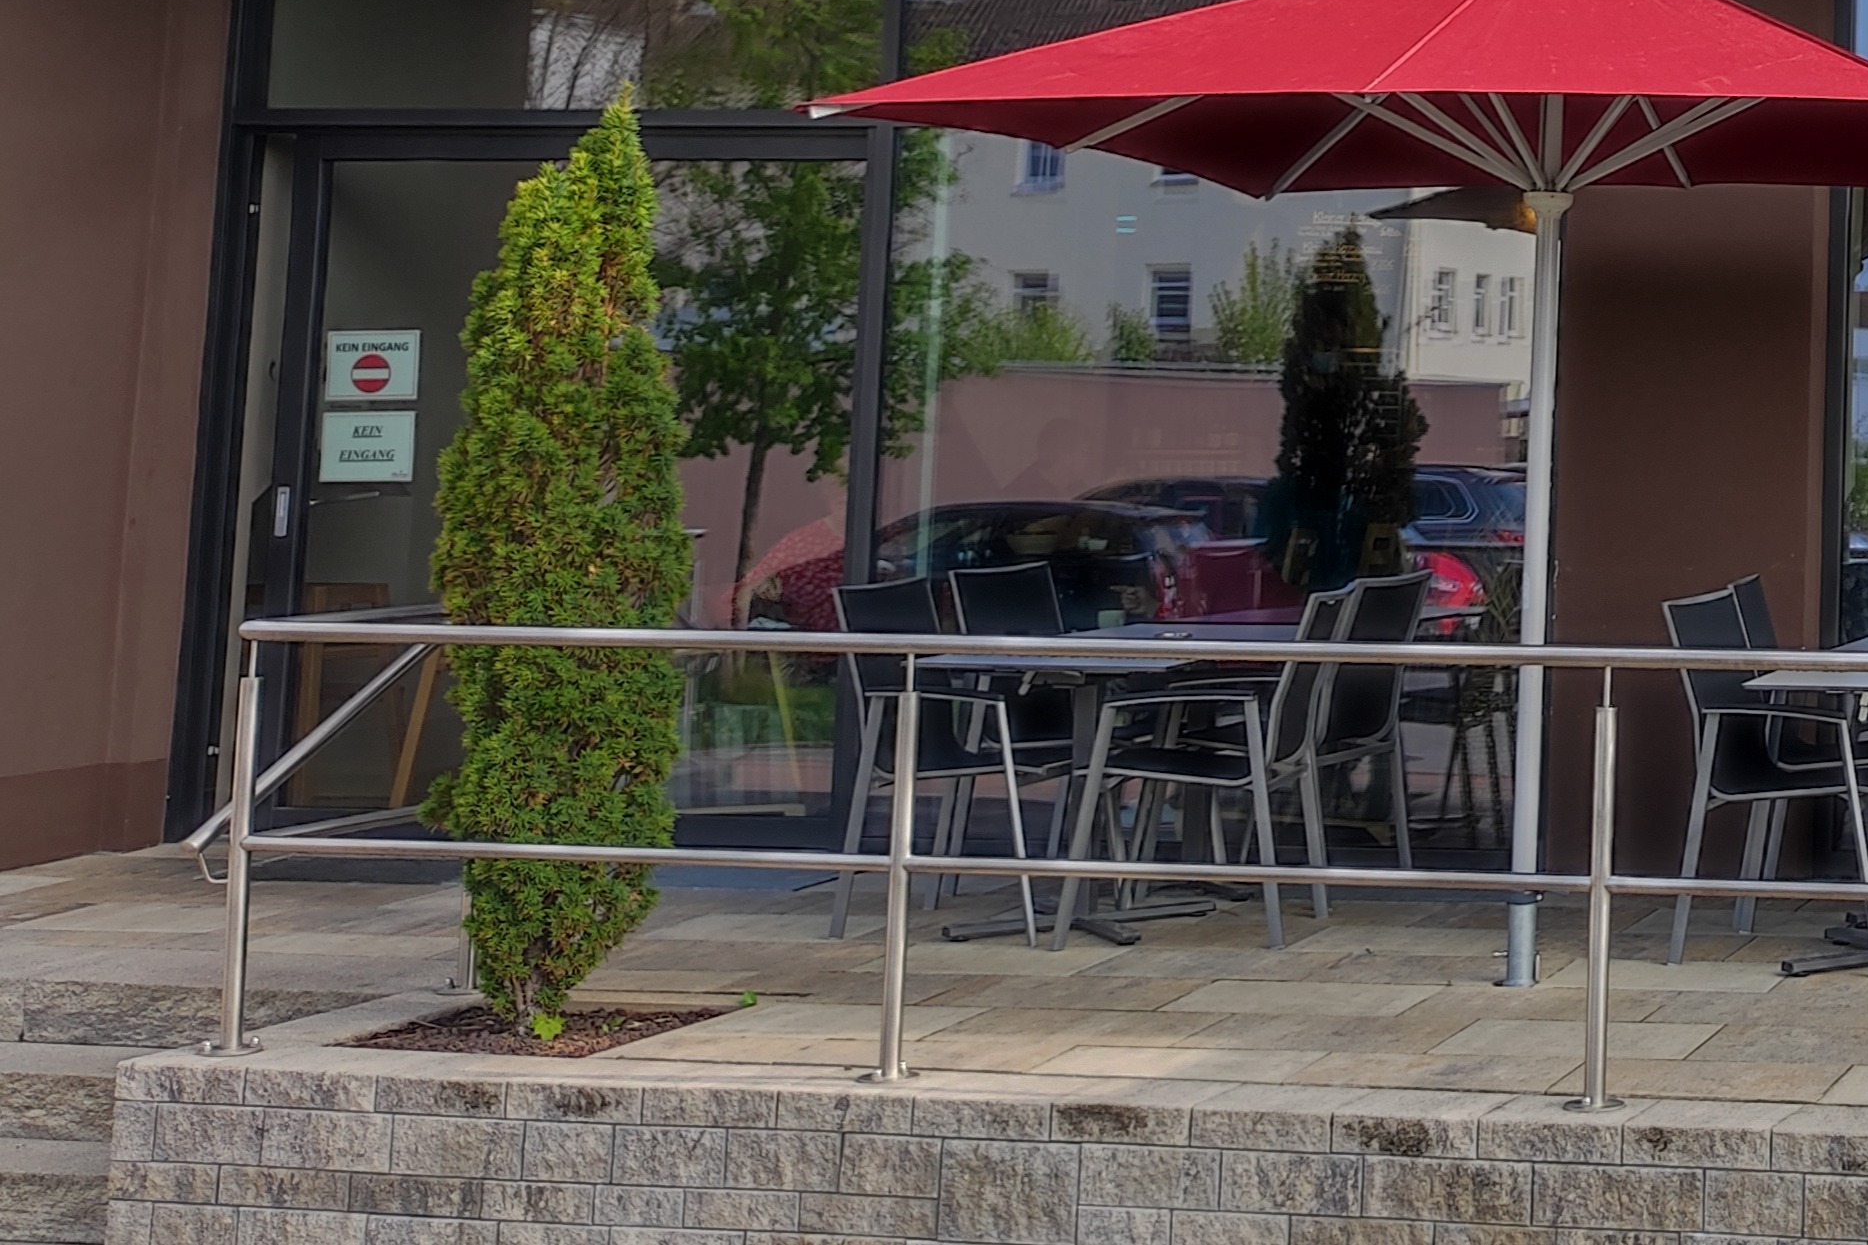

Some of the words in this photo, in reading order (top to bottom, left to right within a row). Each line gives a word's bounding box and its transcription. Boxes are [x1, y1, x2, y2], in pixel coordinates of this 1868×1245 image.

[336, 342, 359, 353] KEIN
[361, 342, 409, 352] EINGANG
[352, 425, 383, 437] KEIN
[339, 449, 394, 461] EINGANG
